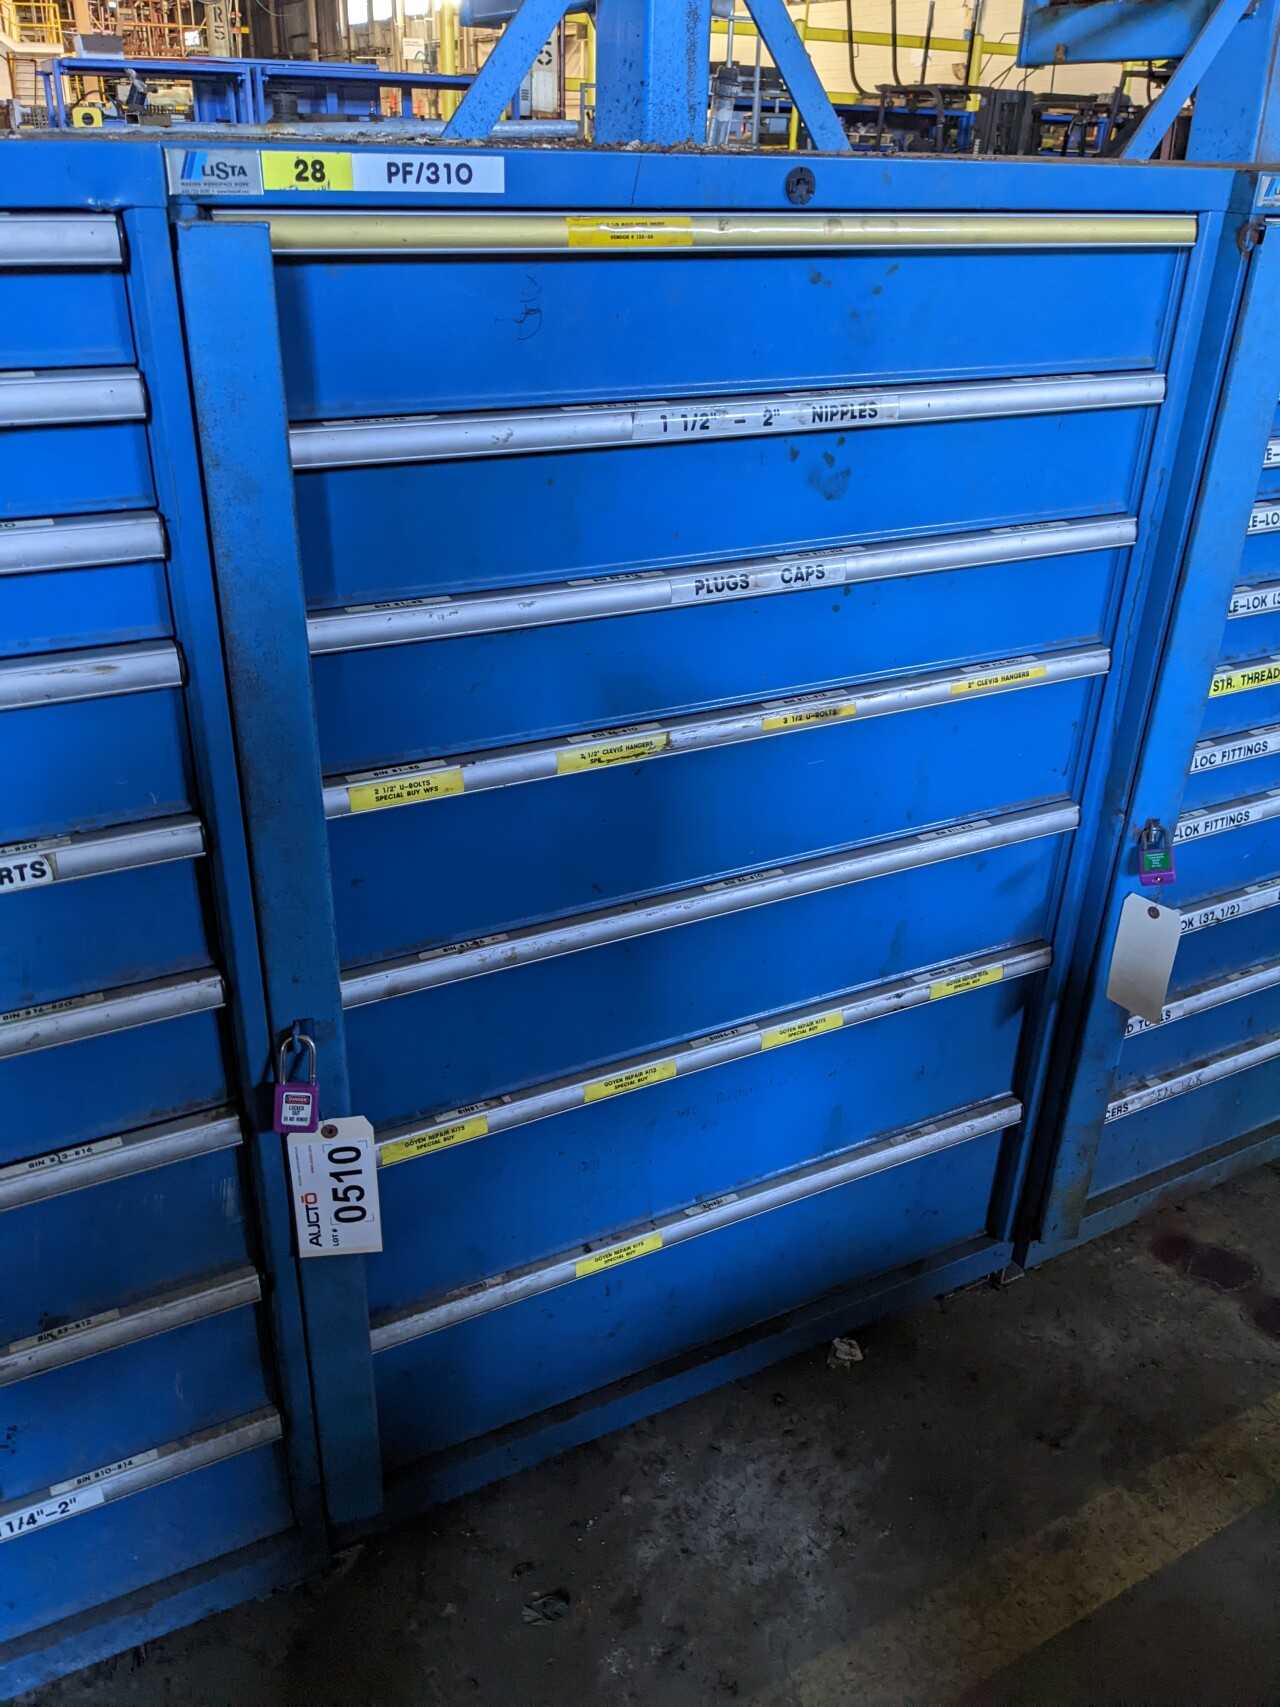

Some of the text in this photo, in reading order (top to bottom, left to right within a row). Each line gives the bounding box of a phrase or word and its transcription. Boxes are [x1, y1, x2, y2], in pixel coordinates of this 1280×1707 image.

[201, 162, 248, 180] LISTA
[294, 159, 473, 185] 28 PF/310
[811, 402, 878, 424] NIPPLES
[694, 564, 826, 596] PLUGS CAPS
[1213, 667, 1280, 693] STR. THREAD
[1194, 740, 1268, 769] LOC FITTINGS
[375, 785, 440, 802] SPECIAL BUY WFS
[399, 779, 431, 791] U-BOLTS
[1204, 810, 1250, 832] FITTINGS
[327, 1146, 367, 1223] 0510
[76, 1476, 91, 1485] BIN
